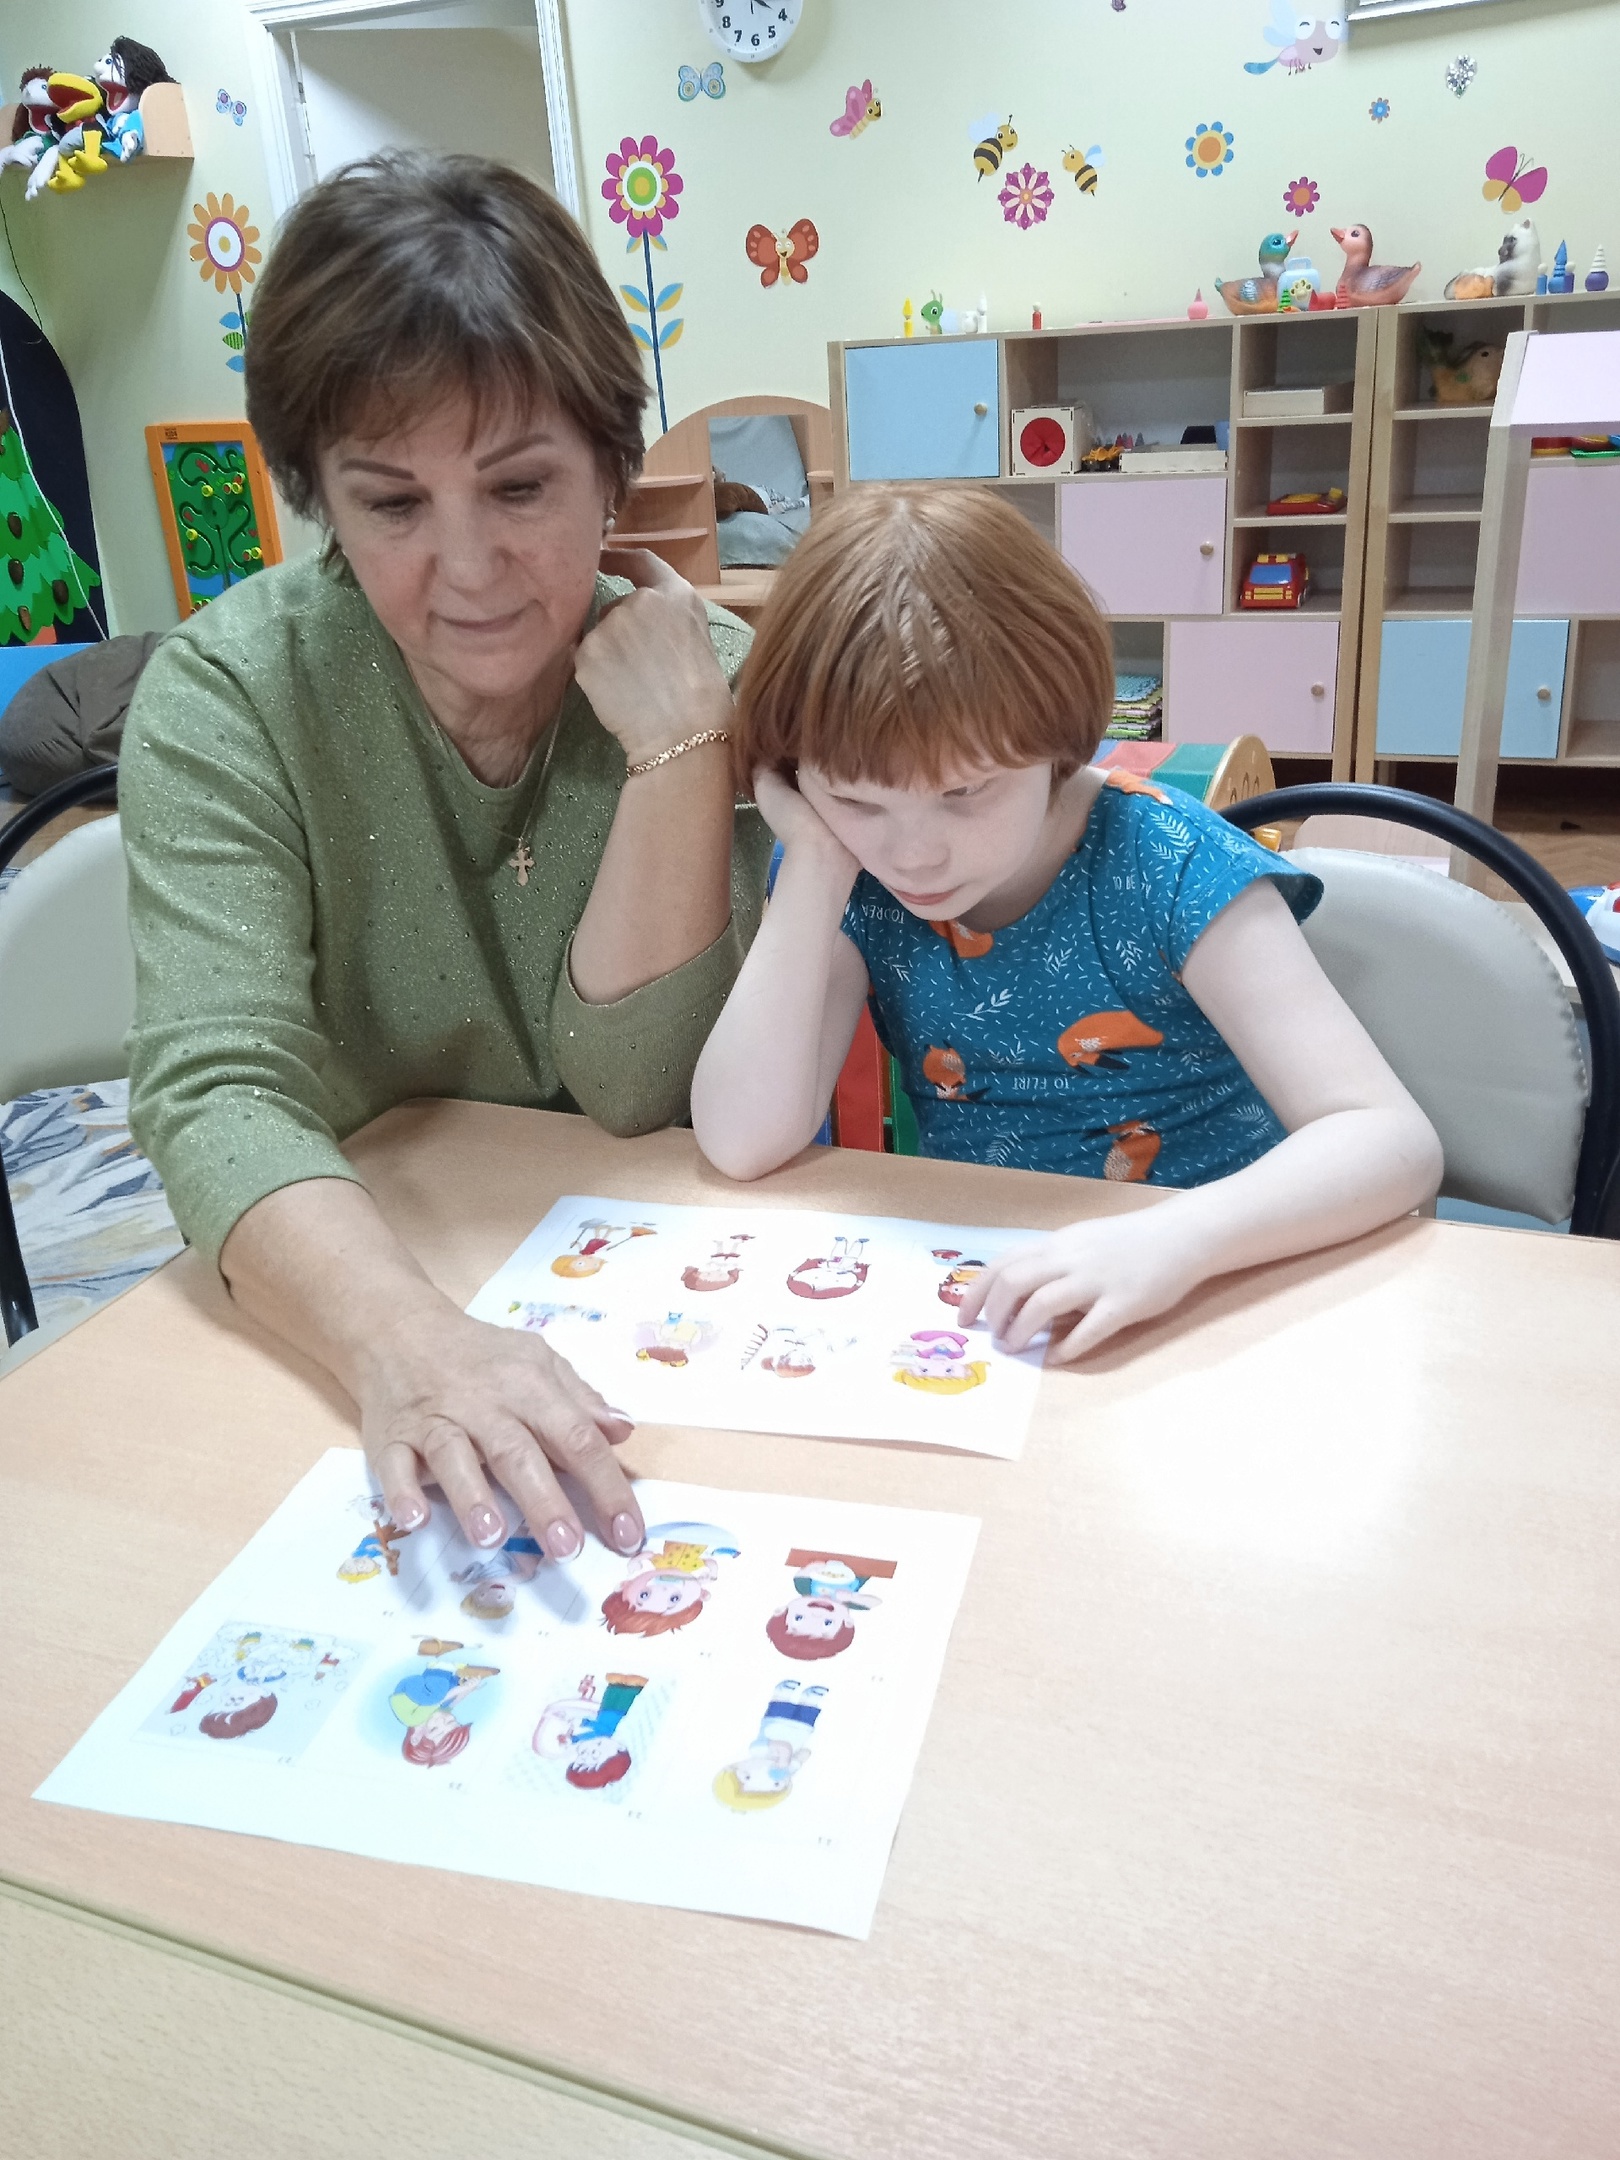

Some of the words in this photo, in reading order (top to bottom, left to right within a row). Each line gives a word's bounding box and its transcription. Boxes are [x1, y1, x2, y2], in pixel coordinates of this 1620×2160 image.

[778, 8, 787, 21] 4
[722, 16, 731, 28] 8
[734, 29, 742, 42] 7
[768, 25, 776, 38] 5
[751, 33, 760, 46] 6
[1126, 874, 1137, 890] BE
[1011, 1076, 1047, 1090] FLIRT
[1053, 1076, 1070, 1090] TO
